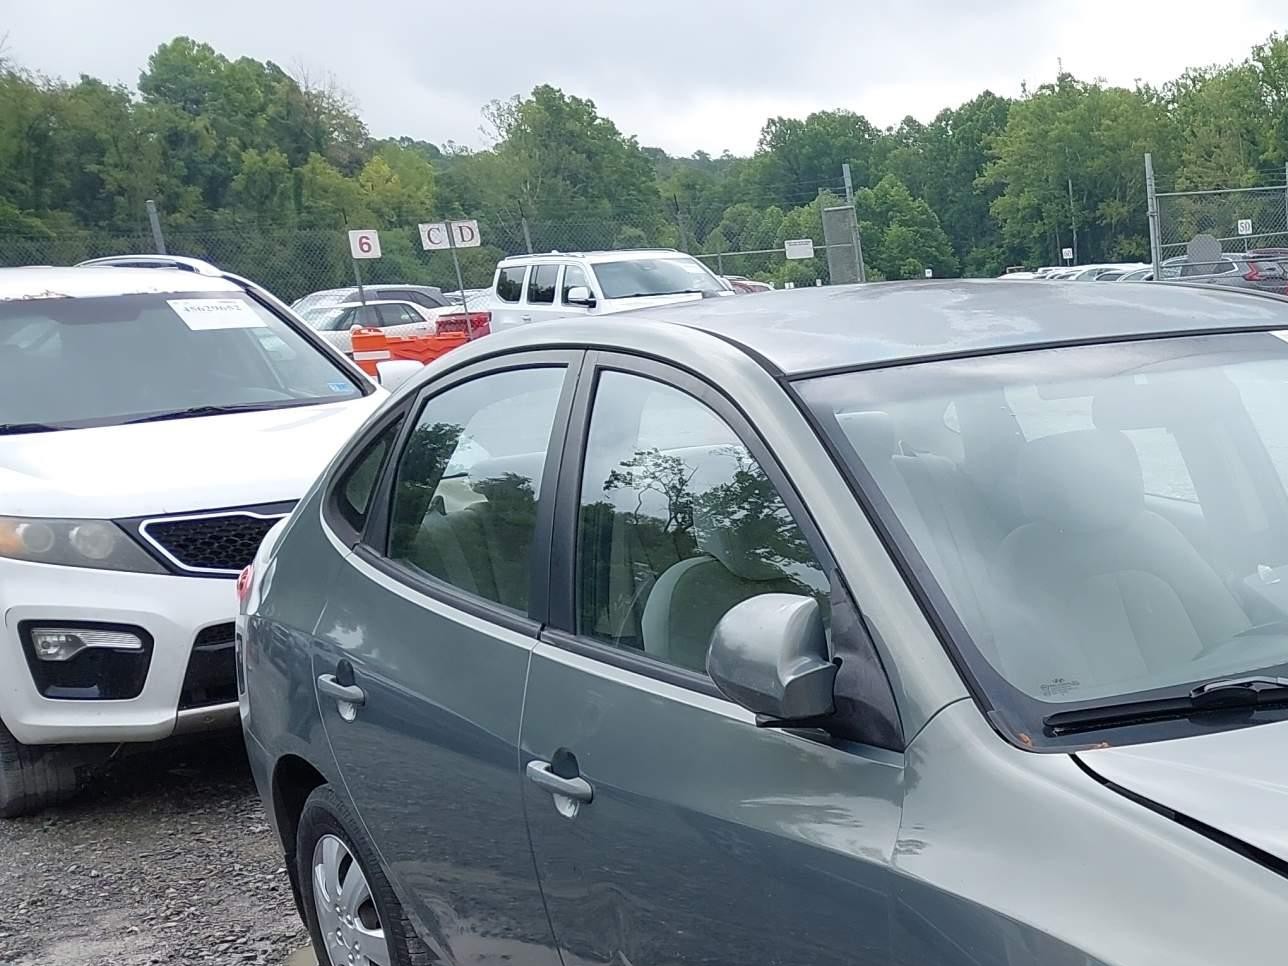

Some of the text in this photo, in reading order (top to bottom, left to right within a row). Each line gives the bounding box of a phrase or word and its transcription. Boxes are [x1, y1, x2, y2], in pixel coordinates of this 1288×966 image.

[358, 235, 372, 254] 6
[427, 225, 475, 245] C D
